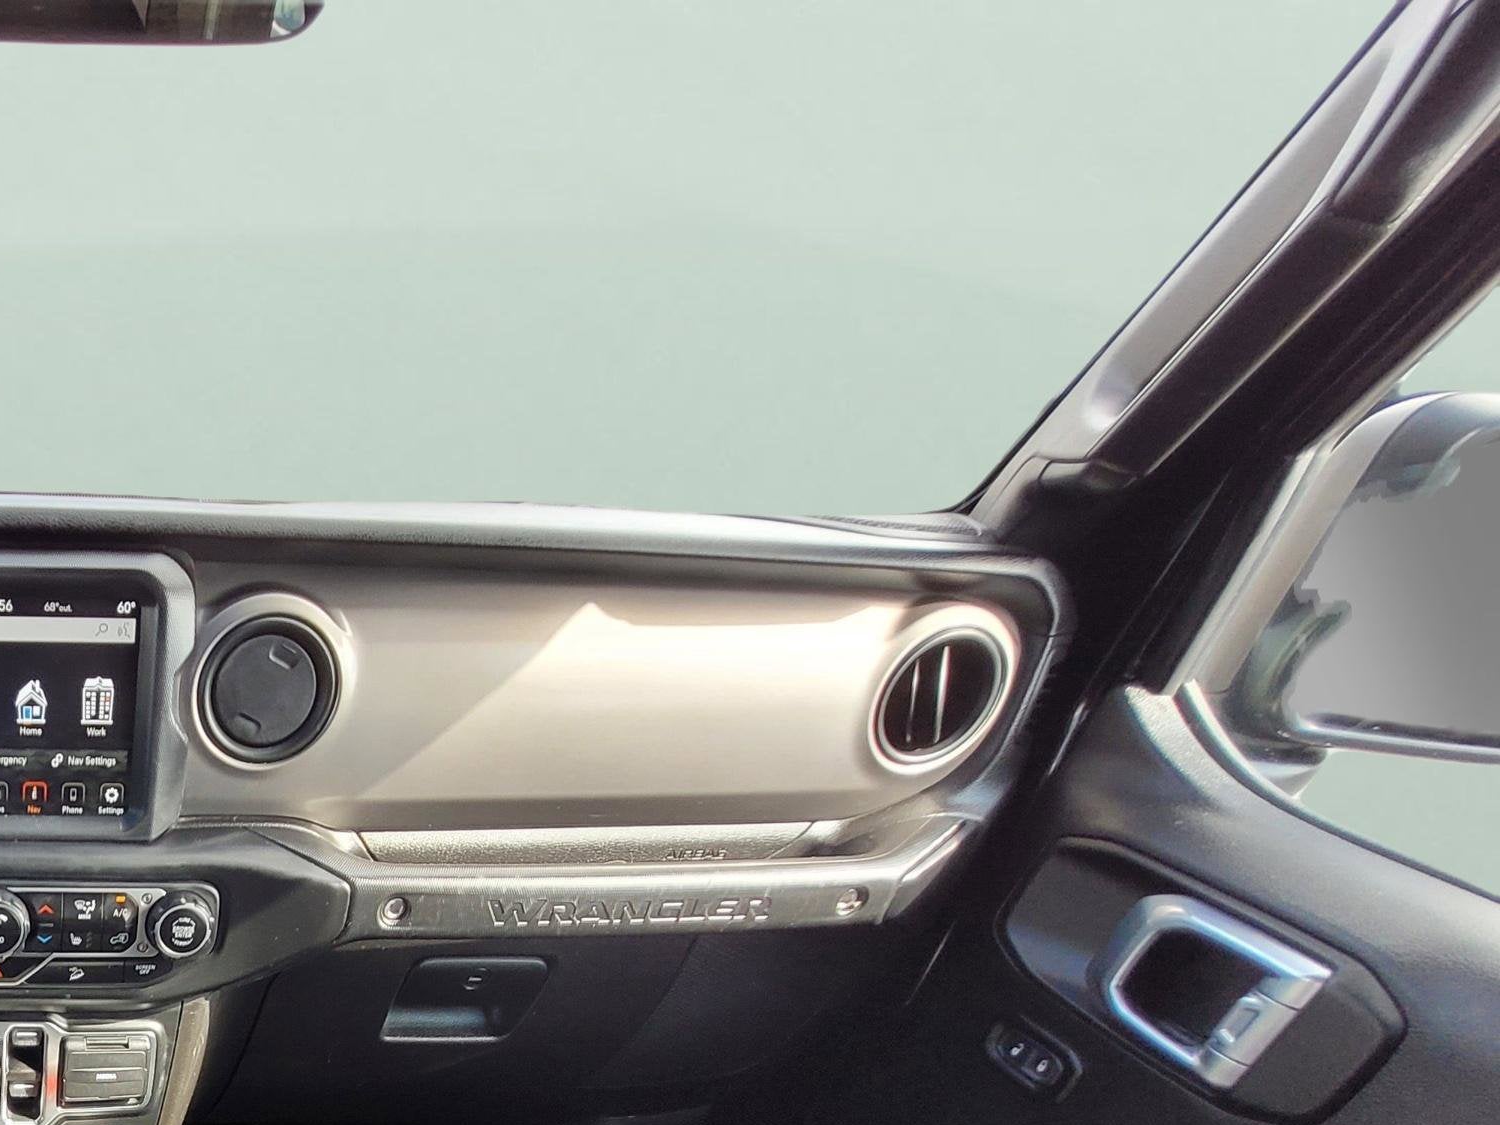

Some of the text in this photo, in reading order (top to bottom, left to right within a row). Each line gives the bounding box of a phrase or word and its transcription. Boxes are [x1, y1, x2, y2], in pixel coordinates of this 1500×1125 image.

[19, 726, 43, 736] Home
[86, 727, 107, 737] Work
[67, 755, 117, 768] Nav Settings
[27, 805, 42, 814] Nav
[61, 805, 84, 815] Phone
[98, 806, 124, 816] Settings
[112, 908, 129, 918] A/C
[488, 897, 773, 927] WRANGLER
